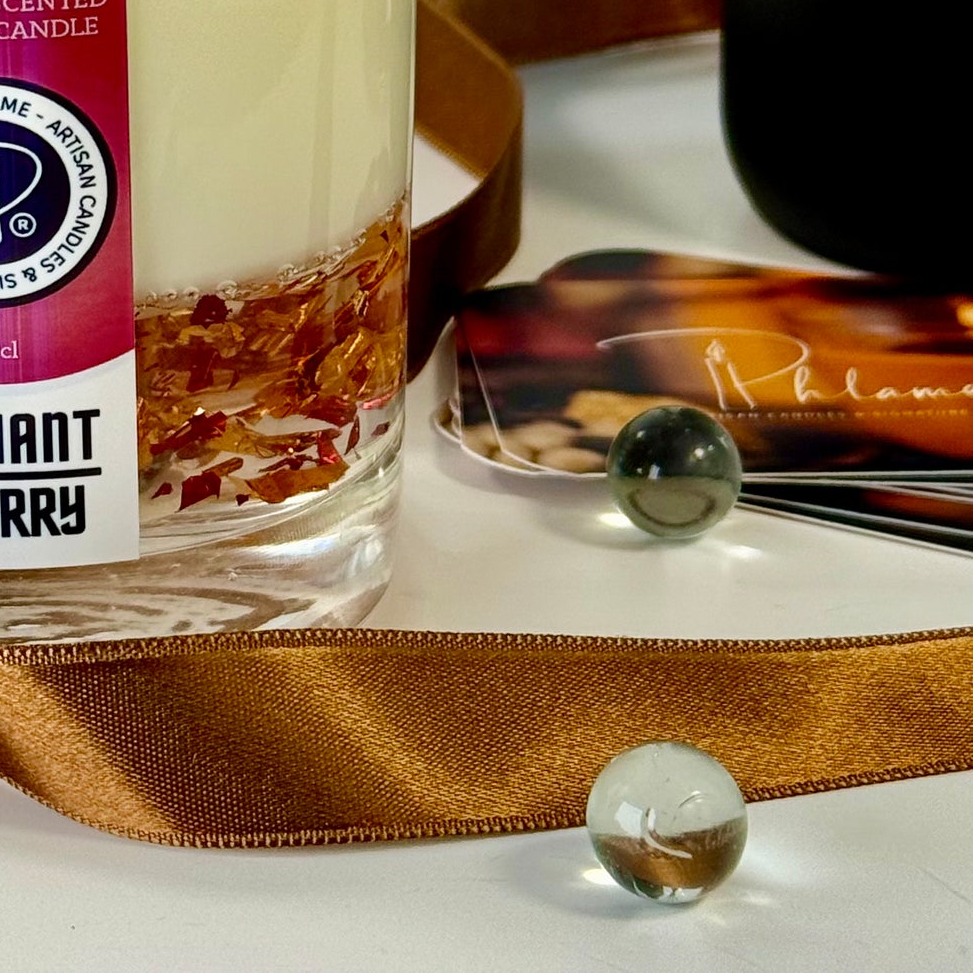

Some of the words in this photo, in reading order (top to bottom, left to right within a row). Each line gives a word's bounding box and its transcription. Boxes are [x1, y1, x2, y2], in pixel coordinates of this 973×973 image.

[45, 119, 97, 189] ARTISAN
[40, 195, 97, 273] CANDLES
[21, 267, 38, 283] &
